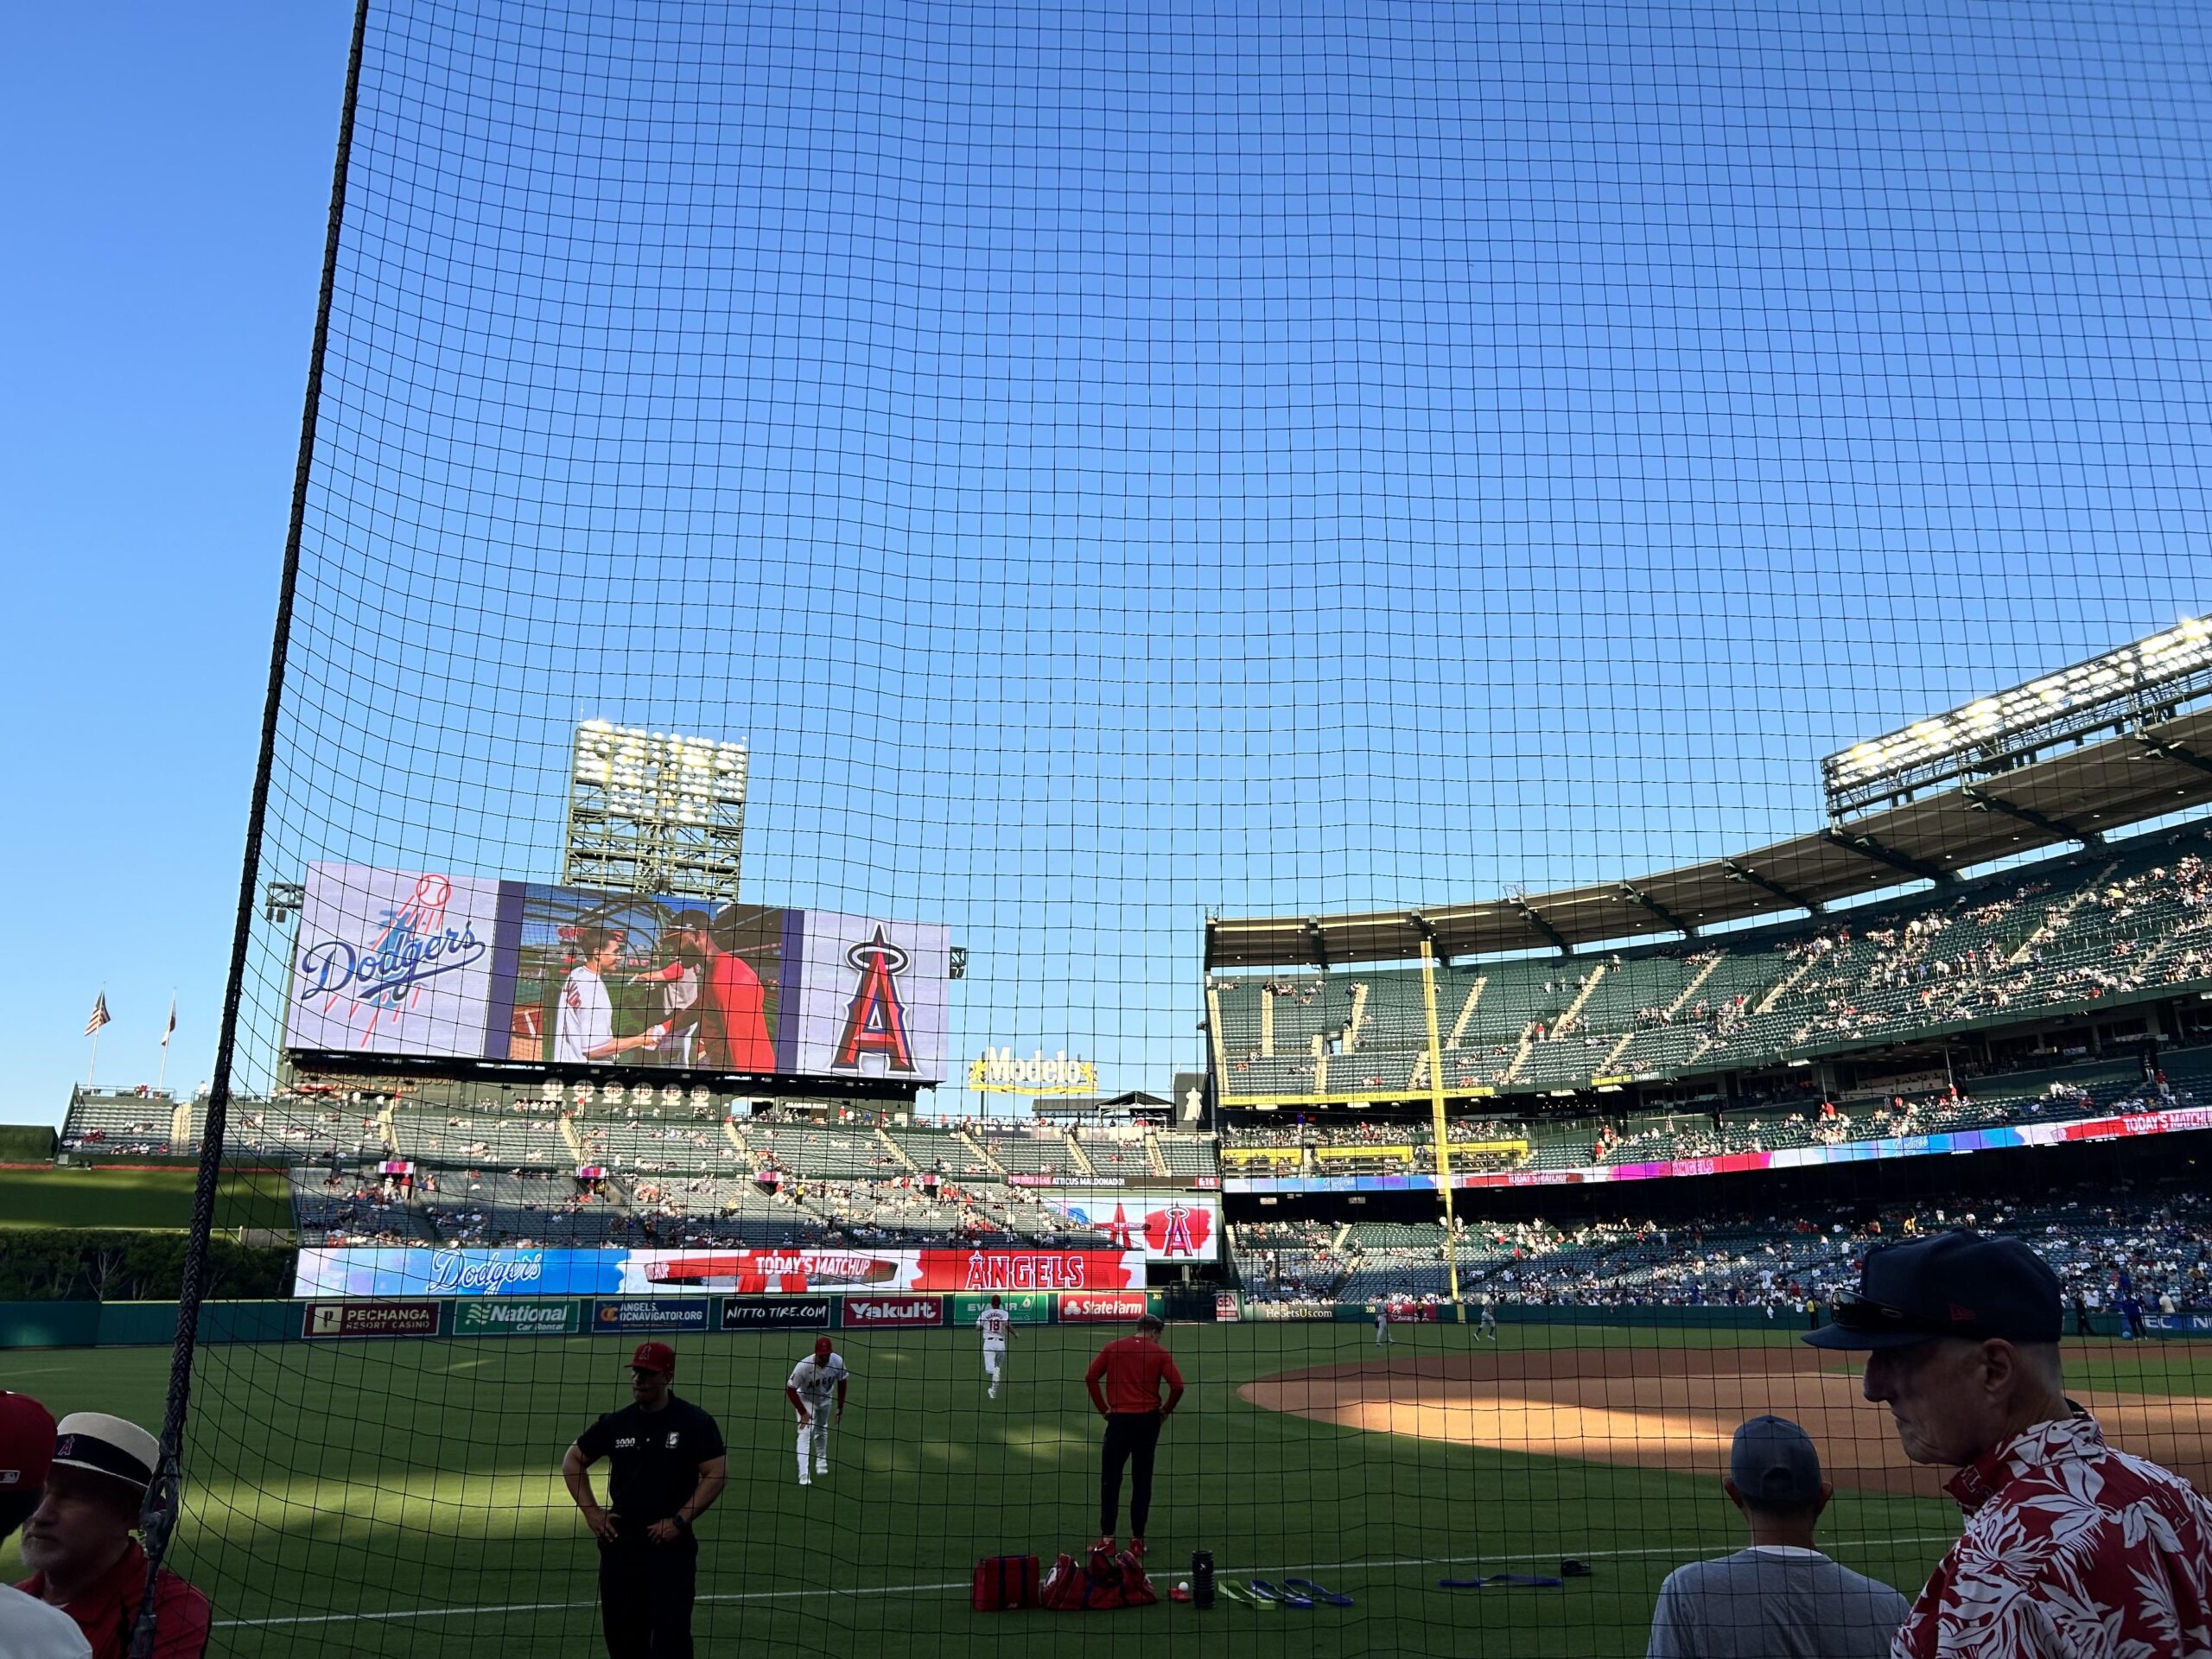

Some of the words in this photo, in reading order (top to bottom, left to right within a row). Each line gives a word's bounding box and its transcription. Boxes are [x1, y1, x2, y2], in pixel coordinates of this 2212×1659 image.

[301, 921, 486, 1001] Dodgers
[986, 1046, 1080, 1083] Modelo
[2122, 1114, 2169, 1132] TODAY'S
[2170, 1111, 2212, 1128] MATCHU
[1672, 1160, 1714, 1176] ANGELS
[1052, 1177, 1079, 1185] ATTICUS
[426, 1249, 543, 1295] Dodgers
[756, 1256, 813, 1275] TODAY'S
[816, 1257, 870, 1276] MATCHUP
[964, 1250, 1084, 1290] ANGELS
[347, 1309, 429, 1321] PECHANGA
[490, 1304, 569, 1321] National
[620, 1311, 703, 1321] OCNAVIGATOR.ORG
[727, 1306, 766, 1319] NITTO
[850, 1301, 936, 1319] Yakult
[1266, 1308, 1333, 1318] HeGetsUs.com
[346, 1321, 386, 1330] RESORT
[392, 1320, 429, 1329] CASINO
[517, 1323, 531, 1332] Car
[535, 1323, 564, 1332] Rental
[989, 1319, 1000, 1332] 18
